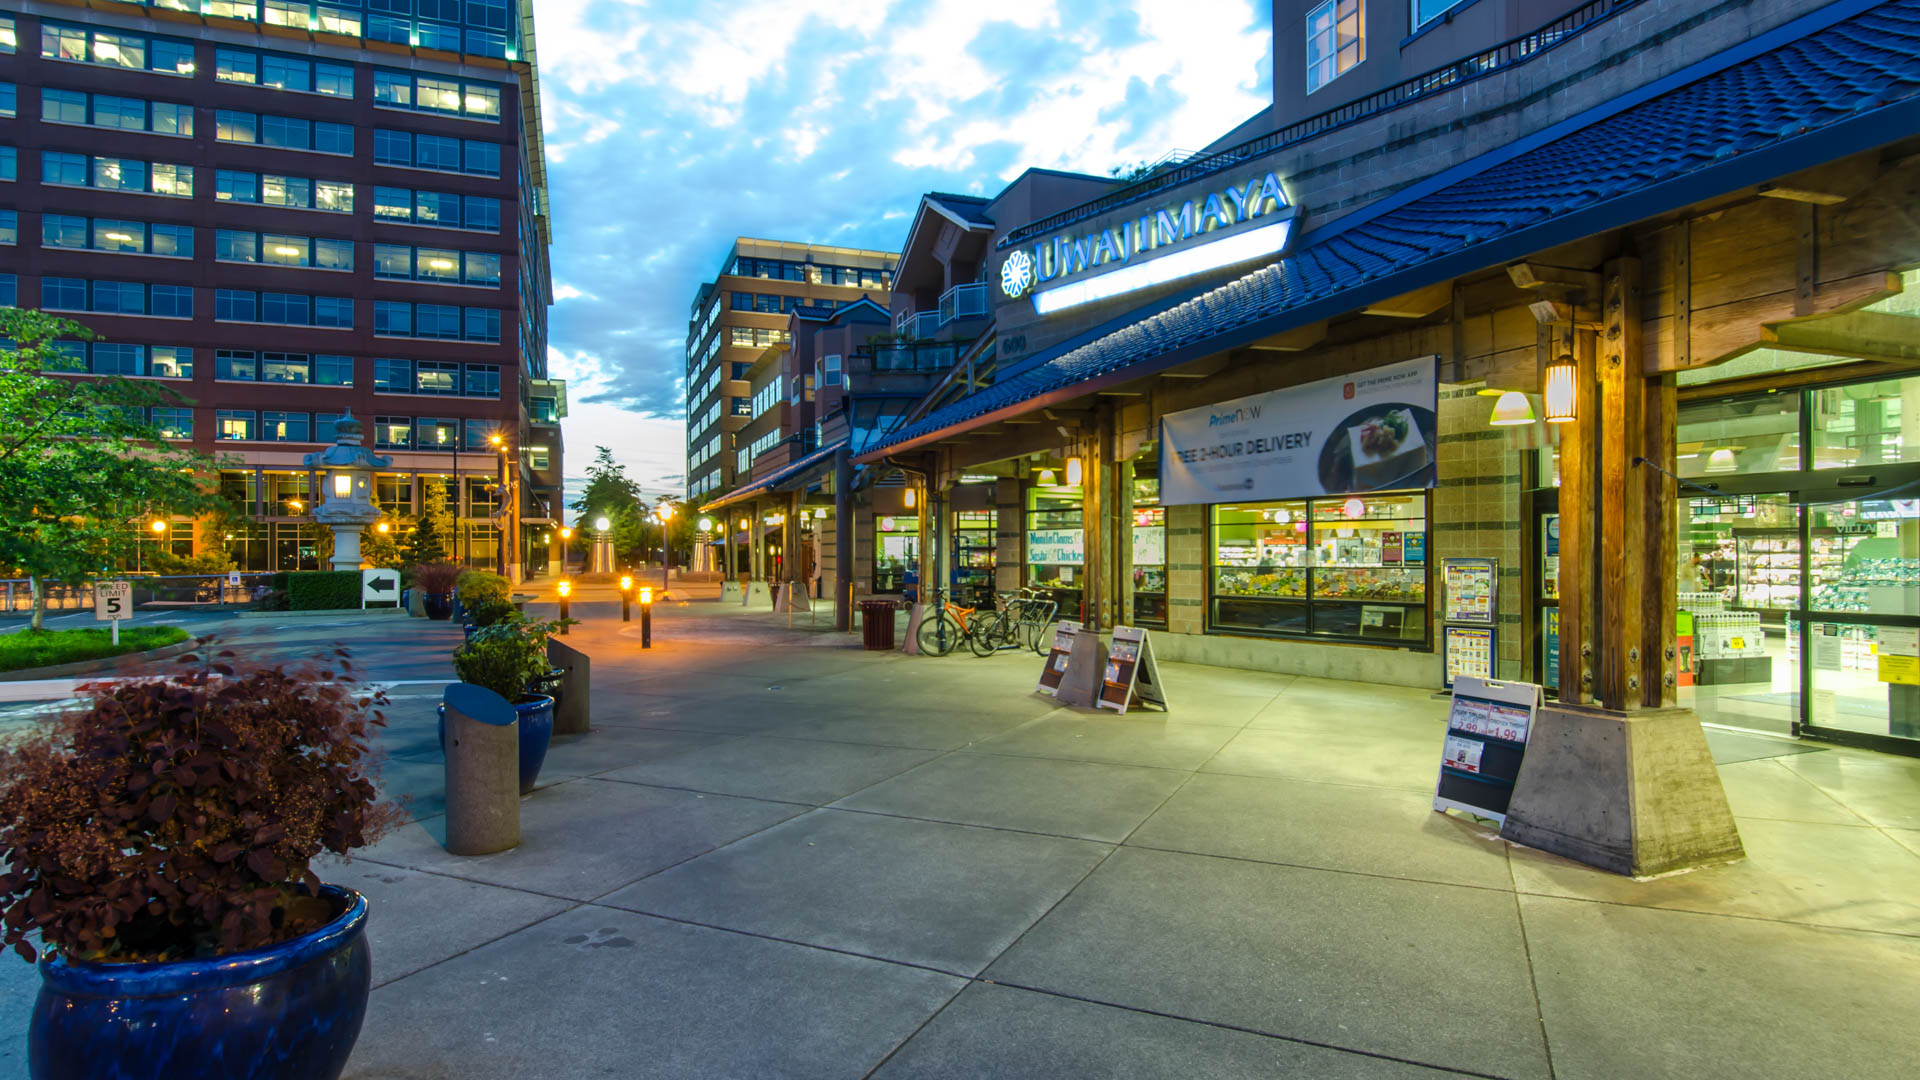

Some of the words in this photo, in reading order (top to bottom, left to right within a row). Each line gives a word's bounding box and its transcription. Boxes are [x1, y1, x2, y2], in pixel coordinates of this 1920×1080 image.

[1035, 172, 1288, 281] UWAJIMAYA
[1200, 442, 1245, 462] 2-HOUR
[1246, 431, 1313, 455] DELIVERY
[107, 598, 121, 613] 5
